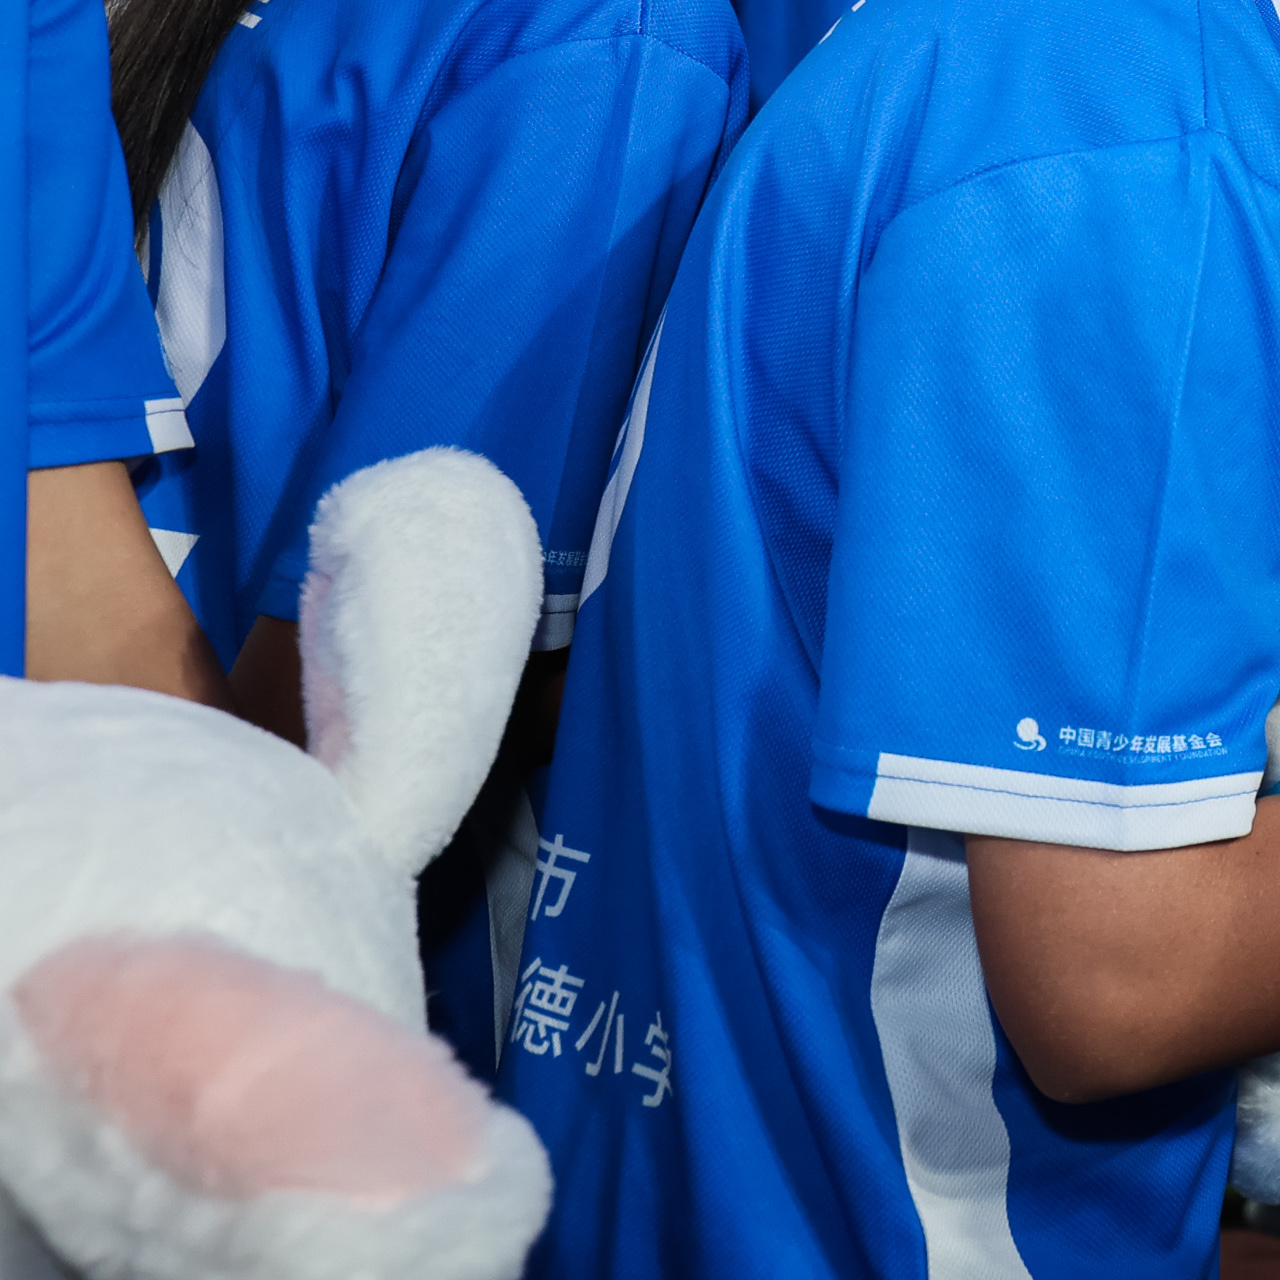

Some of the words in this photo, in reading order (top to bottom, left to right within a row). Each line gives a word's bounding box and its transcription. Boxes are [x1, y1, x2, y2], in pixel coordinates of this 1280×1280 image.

[1058, 724, 1224, 755] 中国青少年发展基金会
